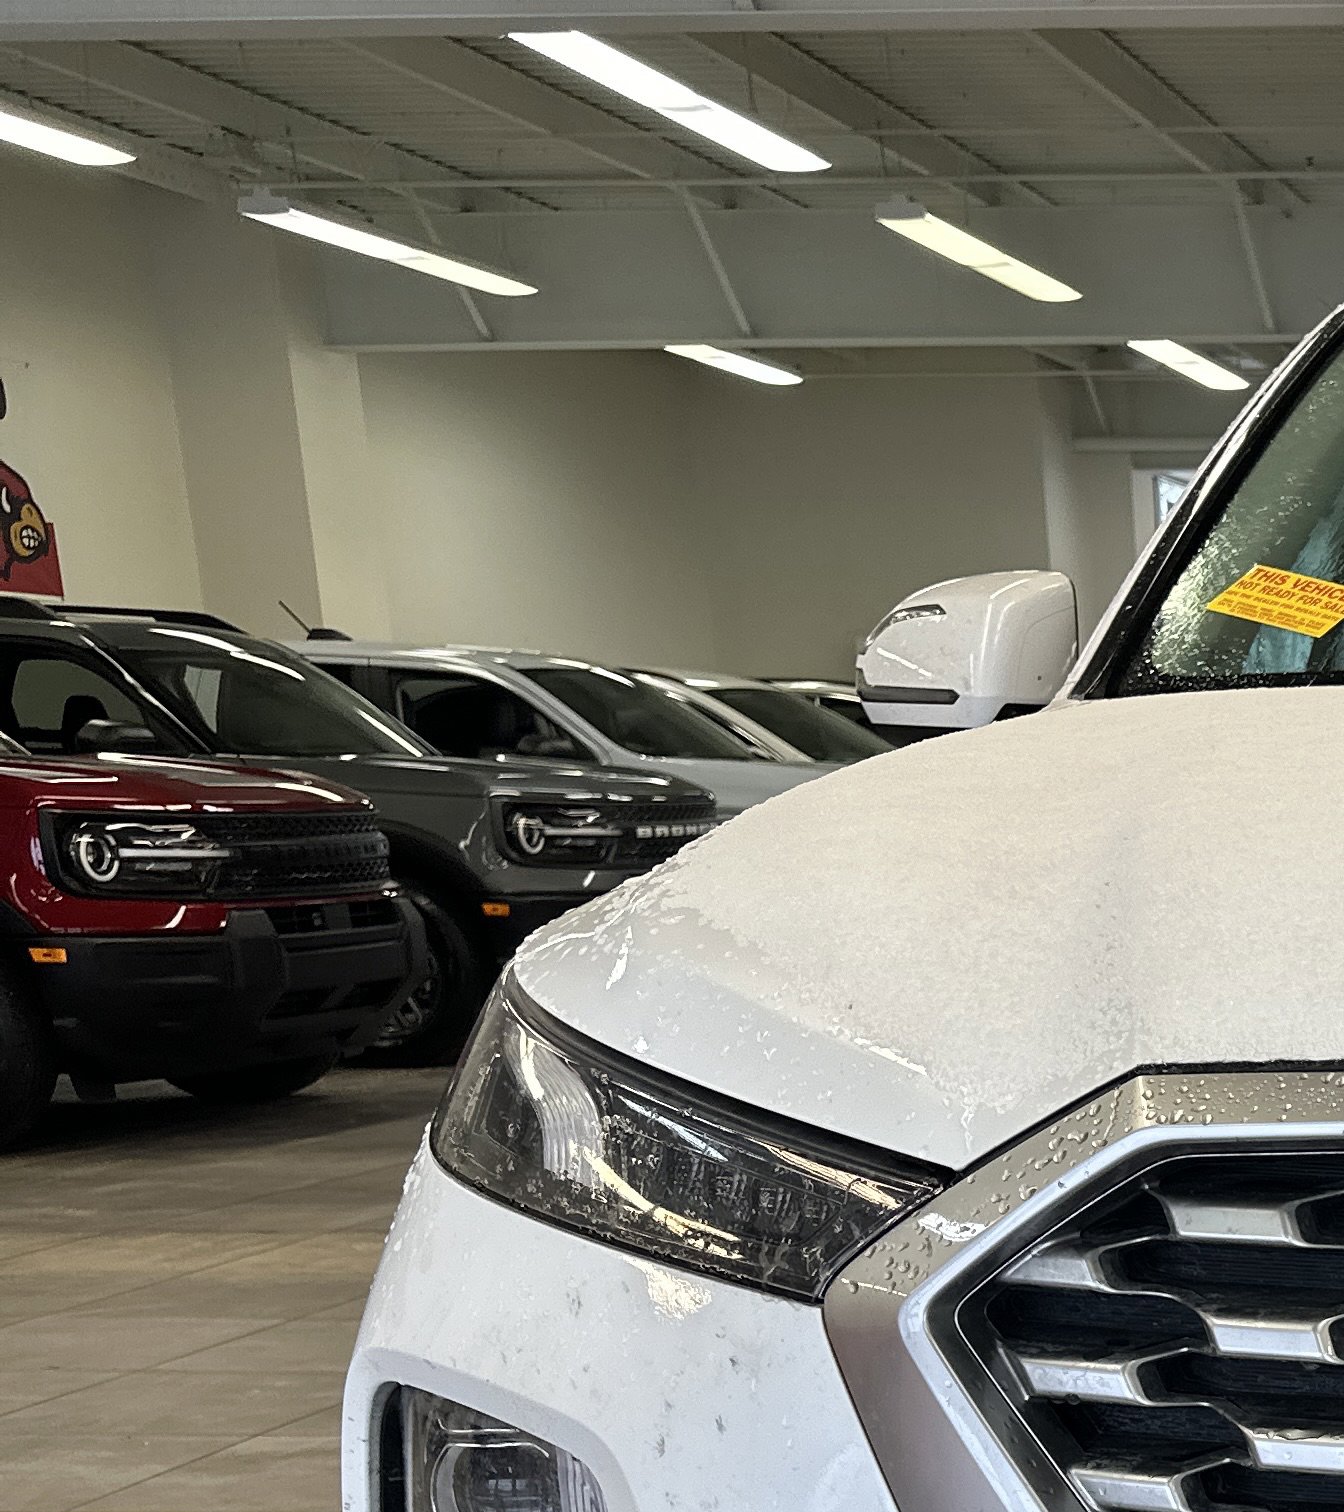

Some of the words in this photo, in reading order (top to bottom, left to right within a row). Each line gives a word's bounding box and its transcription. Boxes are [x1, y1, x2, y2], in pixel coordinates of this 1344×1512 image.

[1249, 567, 1291, 586] THIS
[1235, 579, 1262, 591] NOT
[1261, 584, 1300, 600] READY
[1297, 594, 1323, 607] FOR
